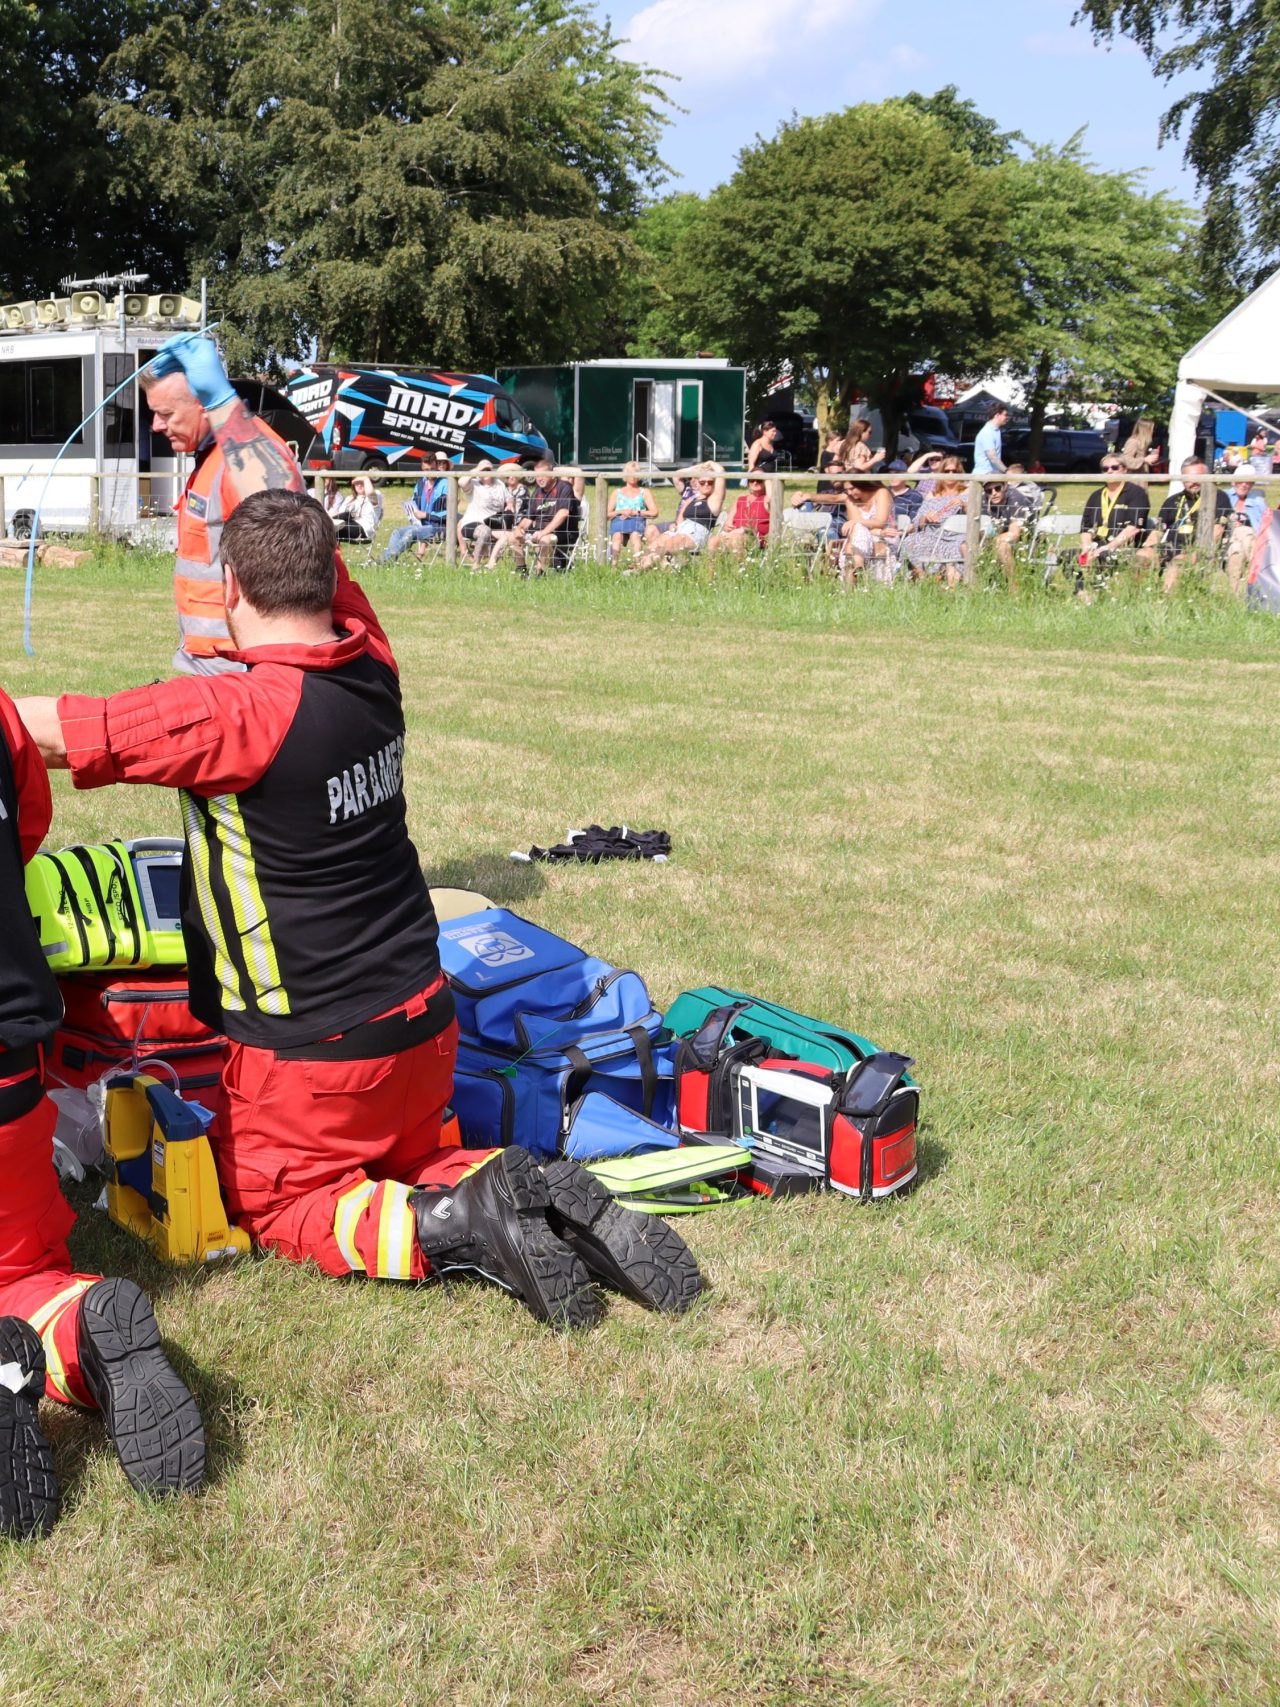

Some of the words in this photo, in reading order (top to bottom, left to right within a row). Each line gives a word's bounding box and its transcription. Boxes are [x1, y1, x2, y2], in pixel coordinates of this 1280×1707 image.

[292, 379, 333, 407] MAD
[297, 396, 331, 412] PORTS
[386, 385, 474, 427] MAD
[381, 410, 467, 444] SPORTS
